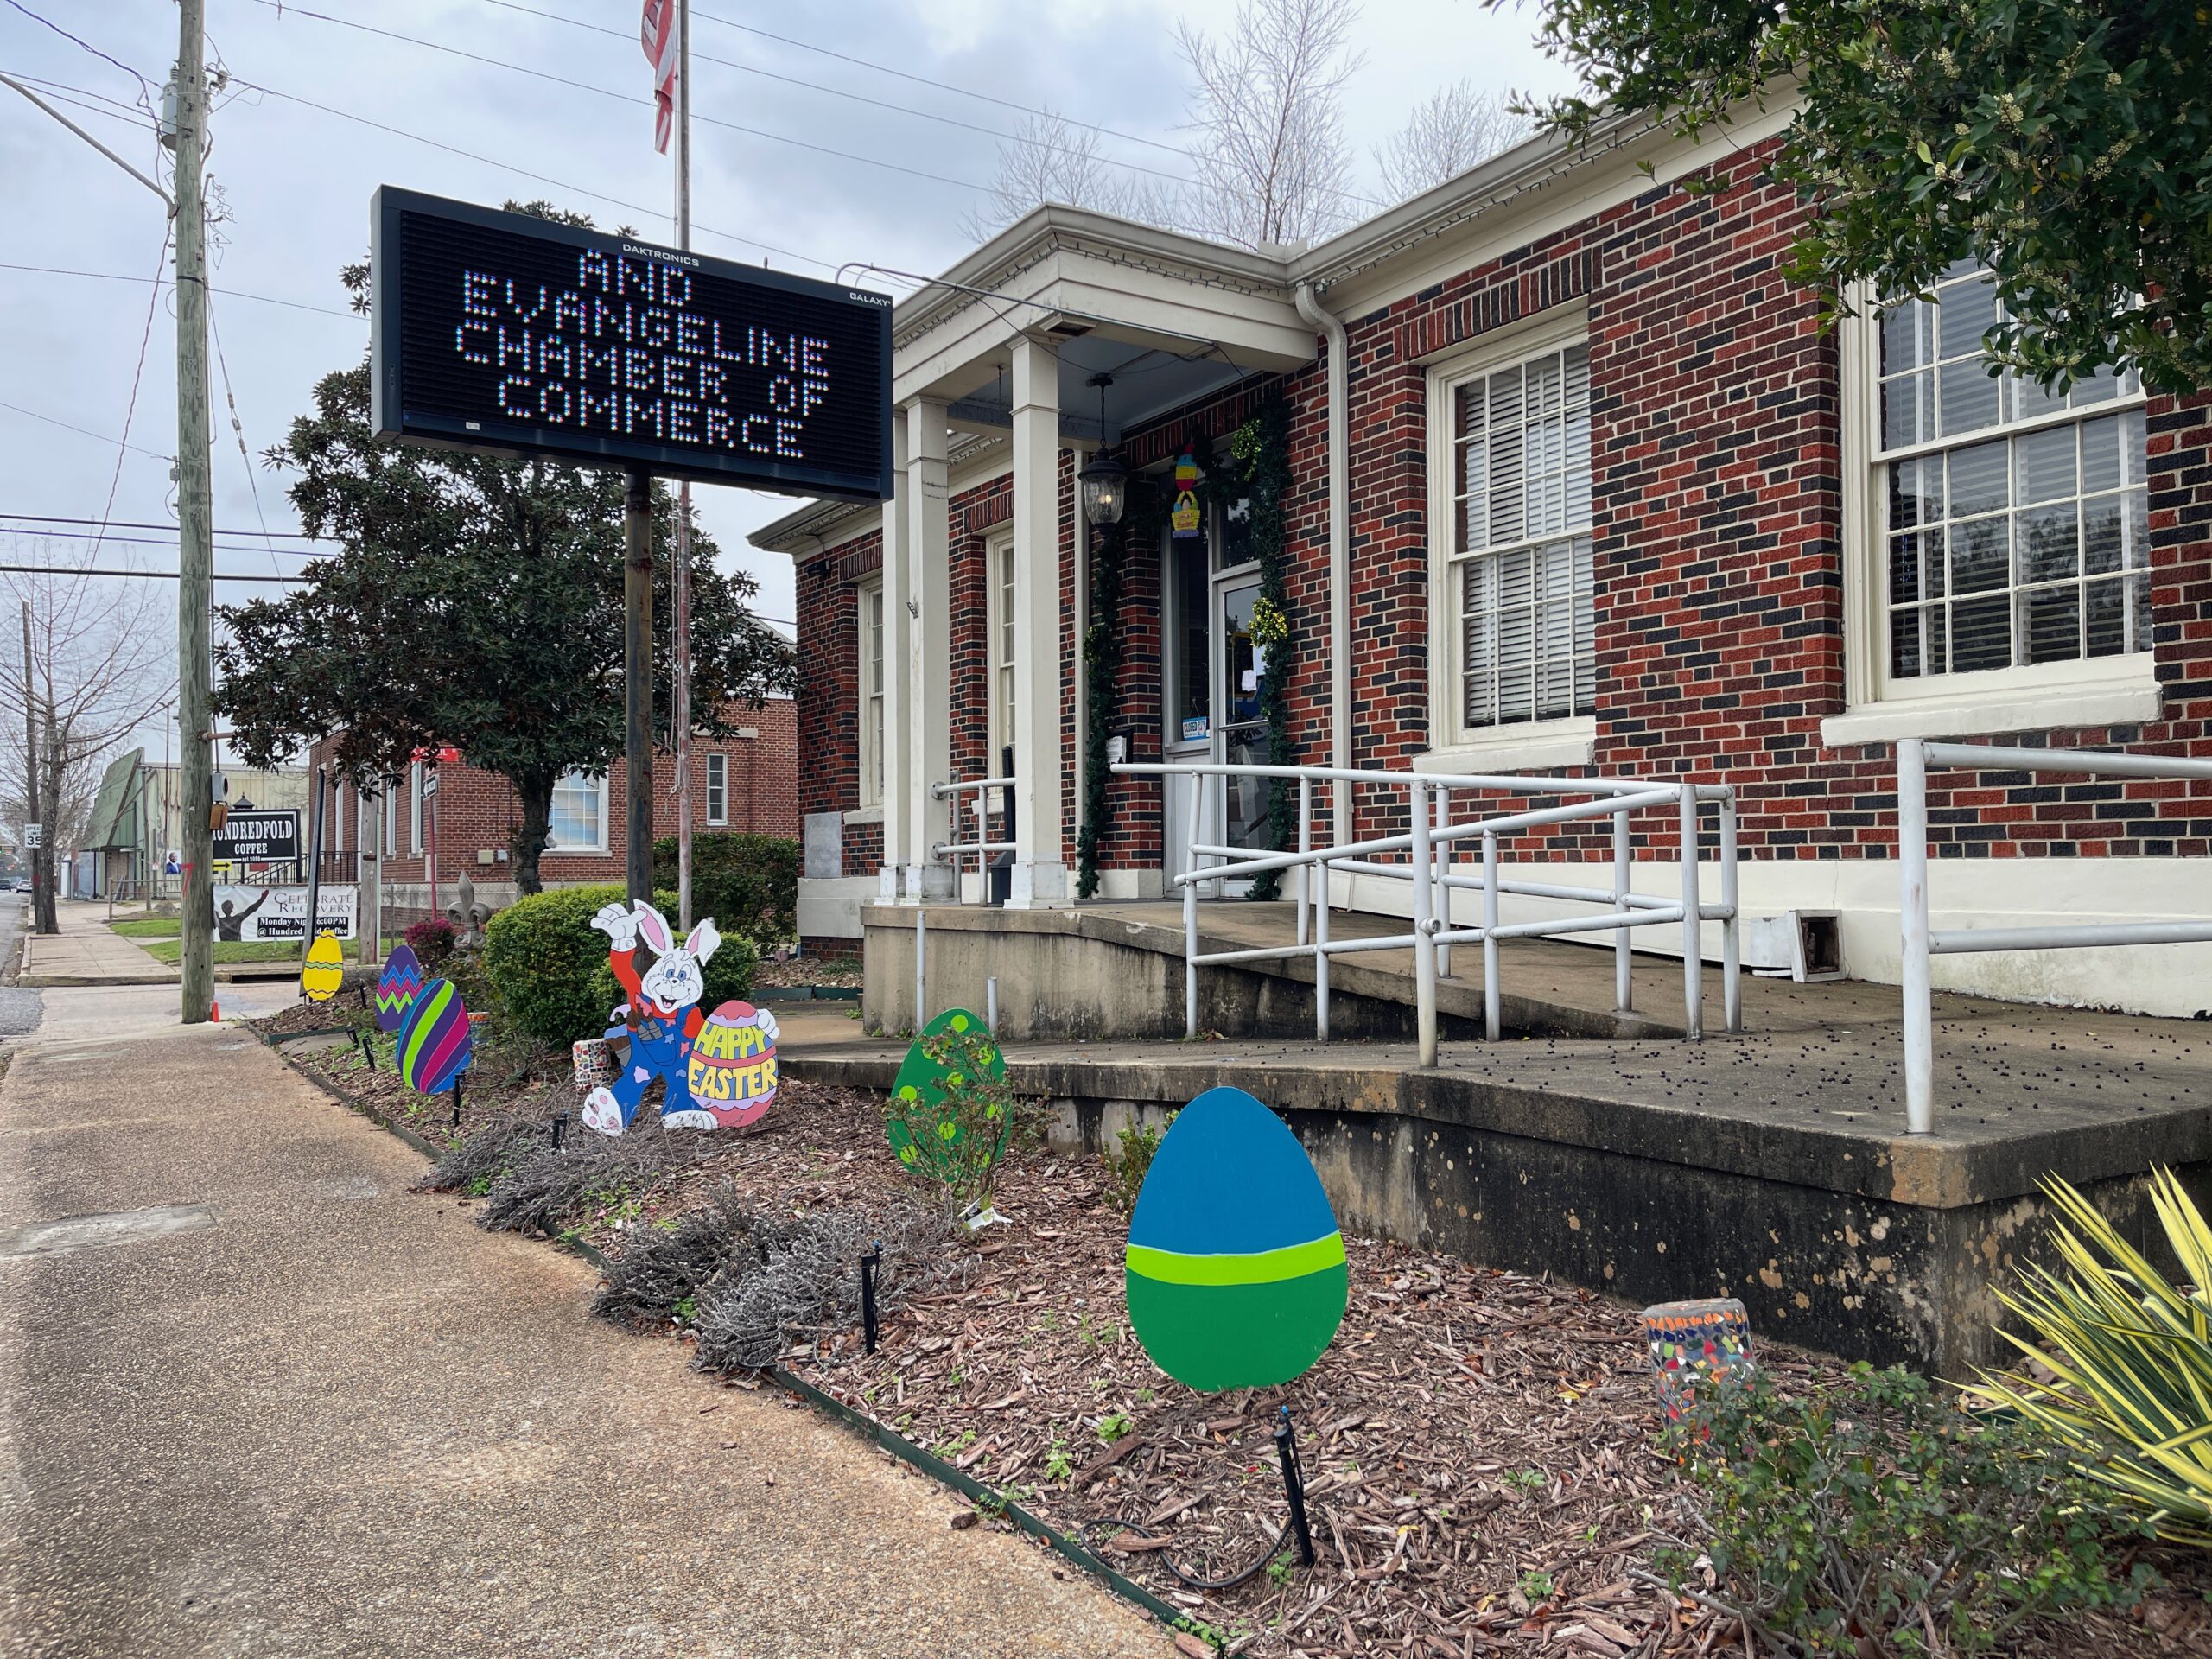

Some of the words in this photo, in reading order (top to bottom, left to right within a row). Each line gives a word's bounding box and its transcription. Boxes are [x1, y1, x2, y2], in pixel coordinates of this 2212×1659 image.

[622, 243, 700, 267] DAKTRONICS
[578, 248, 692, 308] AND
[463, 270, 830, 378] EVANGELINE
[455, 319, 729, 404] CHAMBER
[768, 374, 830, 417] OF
[498, 373, 804, 459] COMMERCE
[27, 836, 41, 846] 35
[234, 842, 268, 855] COFFEE
[259, 917, 292, 927] Monday
[316, 917, 346, 925] 6:00PM
[693, 1020, 768, 1061] HAPPY
[688, 1055, 779, 1100] EASTER
